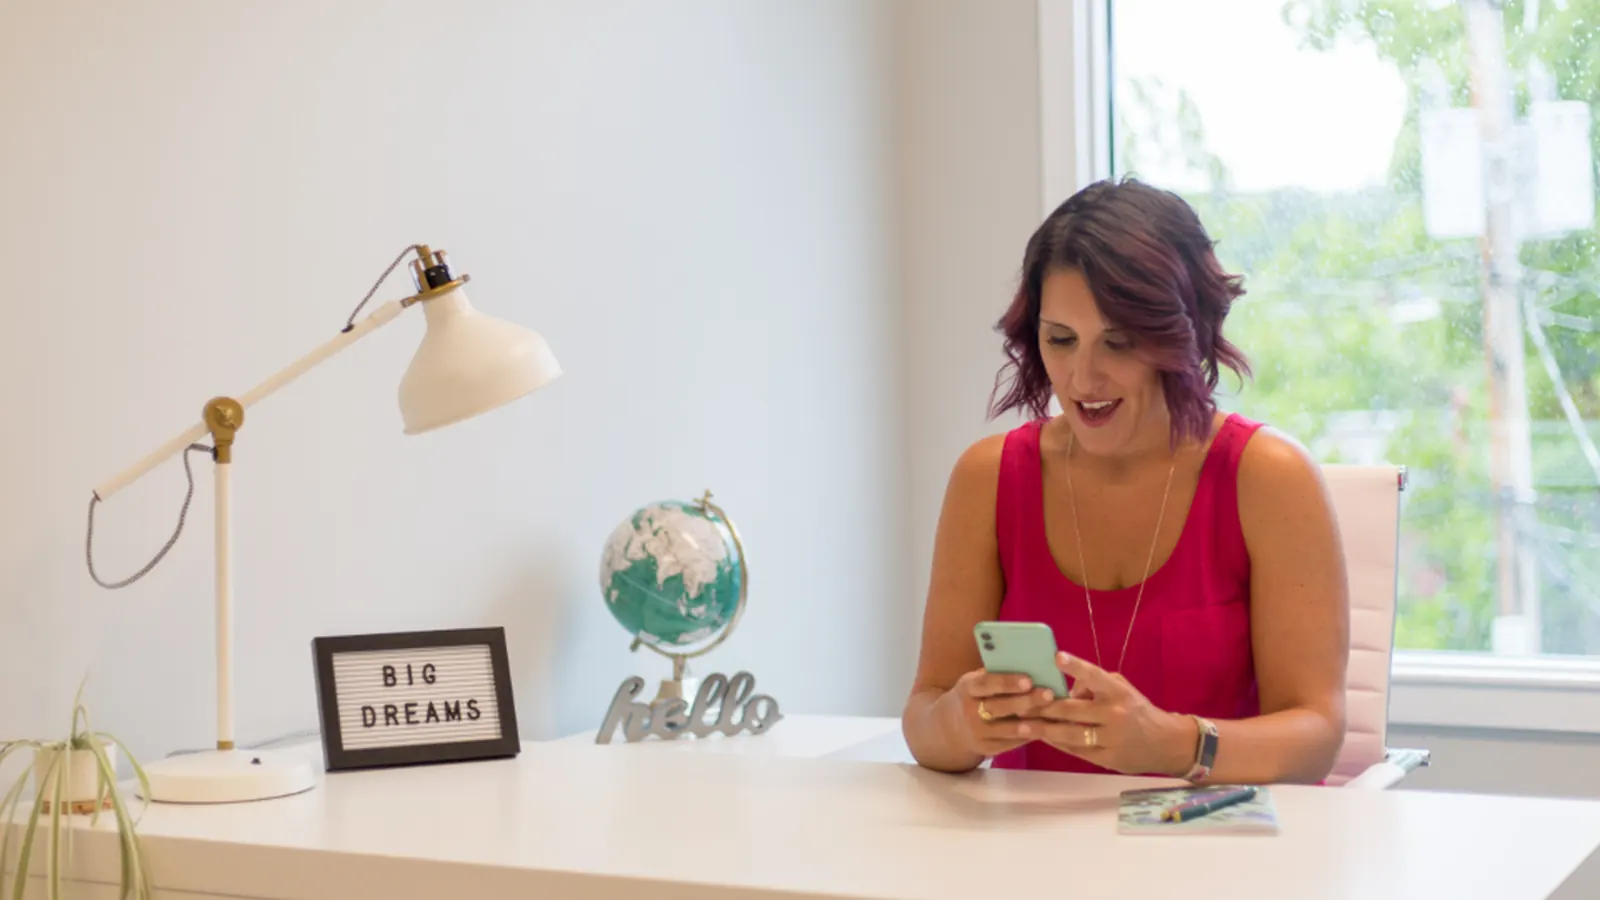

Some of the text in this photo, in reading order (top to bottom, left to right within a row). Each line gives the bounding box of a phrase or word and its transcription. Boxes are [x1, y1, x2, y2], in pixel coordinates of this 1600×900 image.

[382, 663, 436, 687] BIG
[361, 699, 481, 728] DREAMS
[595, 670, 784, 745] hello
